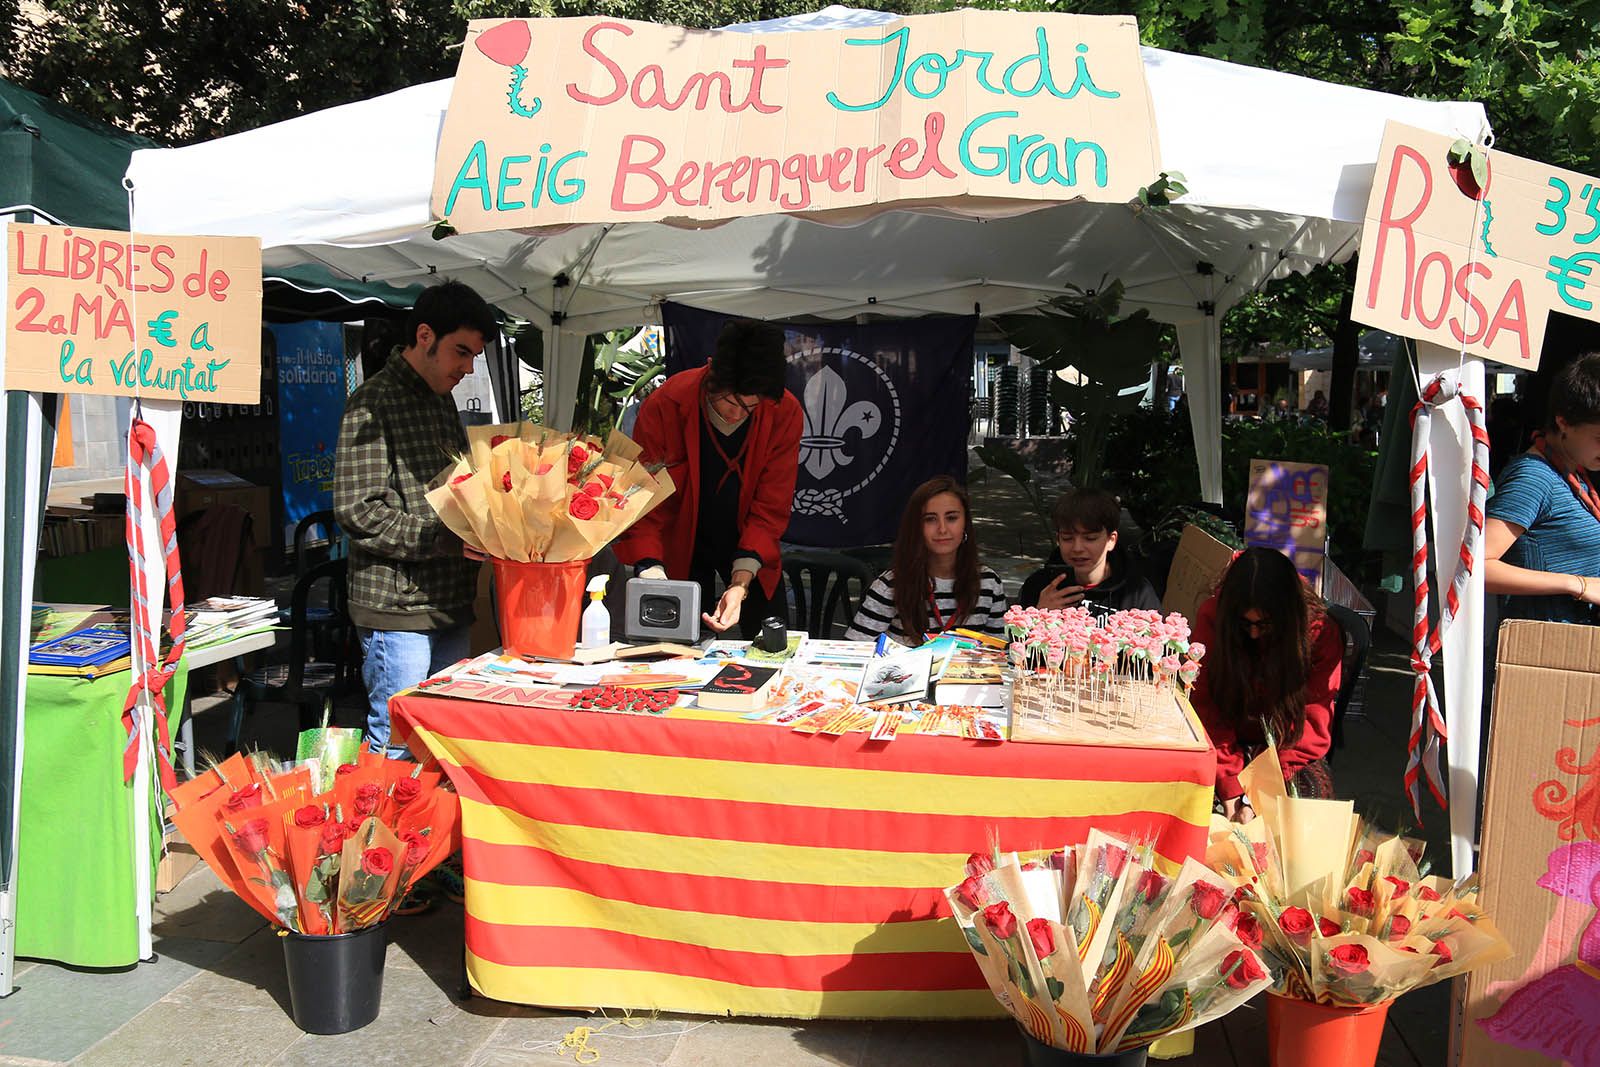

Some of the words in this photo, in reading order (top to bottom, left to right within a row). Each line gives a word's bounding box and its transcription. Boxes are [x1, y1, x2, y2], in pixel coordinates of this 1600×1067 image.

[566, 22, 790, 114] Sant
[826, 26, 1120, 112] Jordi
[610, 134, 886, 210] Berenguer
[884, 112, 958, 180] el
[959, 111, 1108, 188] Gran
[183, 248, 230, 301] de
[1366, 144, 1530, 359] ROSA
[147, 310, 179, 348] €
[190, 322, 214, 351] a
[59, 339, 93, 385] la
[110, 348, 231, 400] voluntat
[437, 680, 577, 708] PINS
